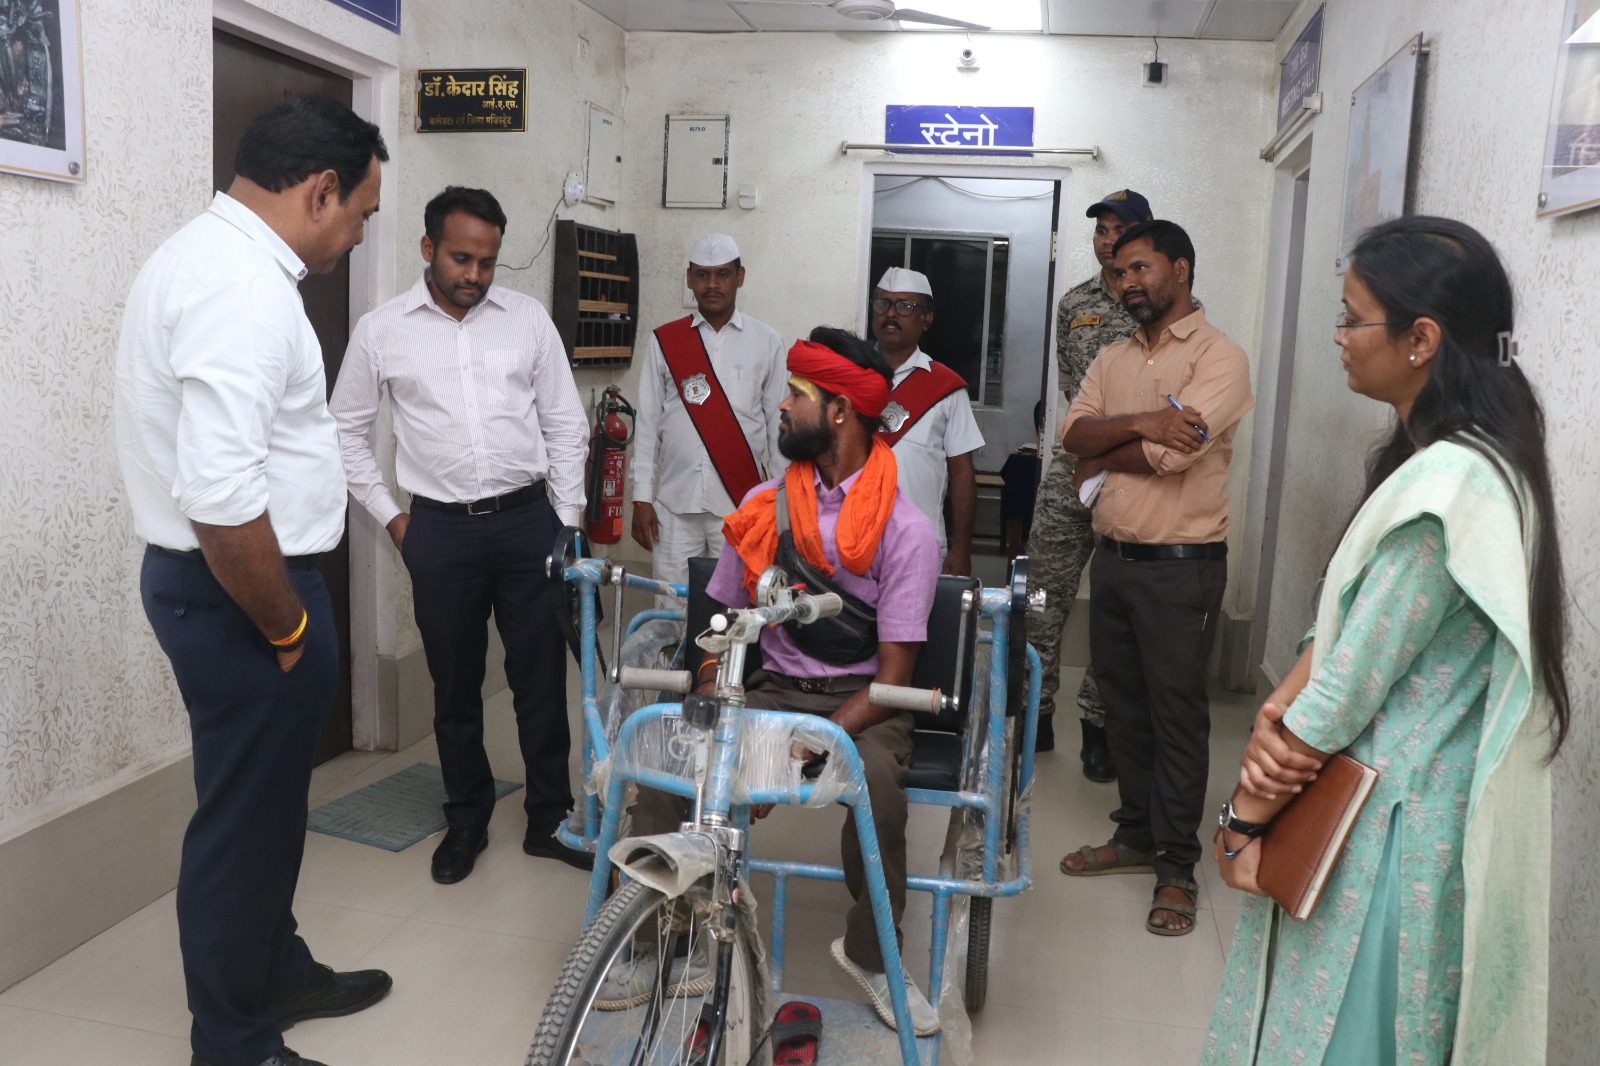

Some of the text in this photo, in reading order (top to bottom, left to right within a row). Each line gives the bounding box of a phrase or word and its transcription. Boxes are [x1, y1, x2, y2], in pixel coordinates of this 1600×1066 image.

[489, 74, 519, 98] सिंह
[1281, 63, 1315, 119] MEETING HALL
[429, 114, 454, 126] कलेक्टर
[485, 113, 512, 128] मजिस्ट्रेट
[919, 113, 998, 146] स्टेनो
